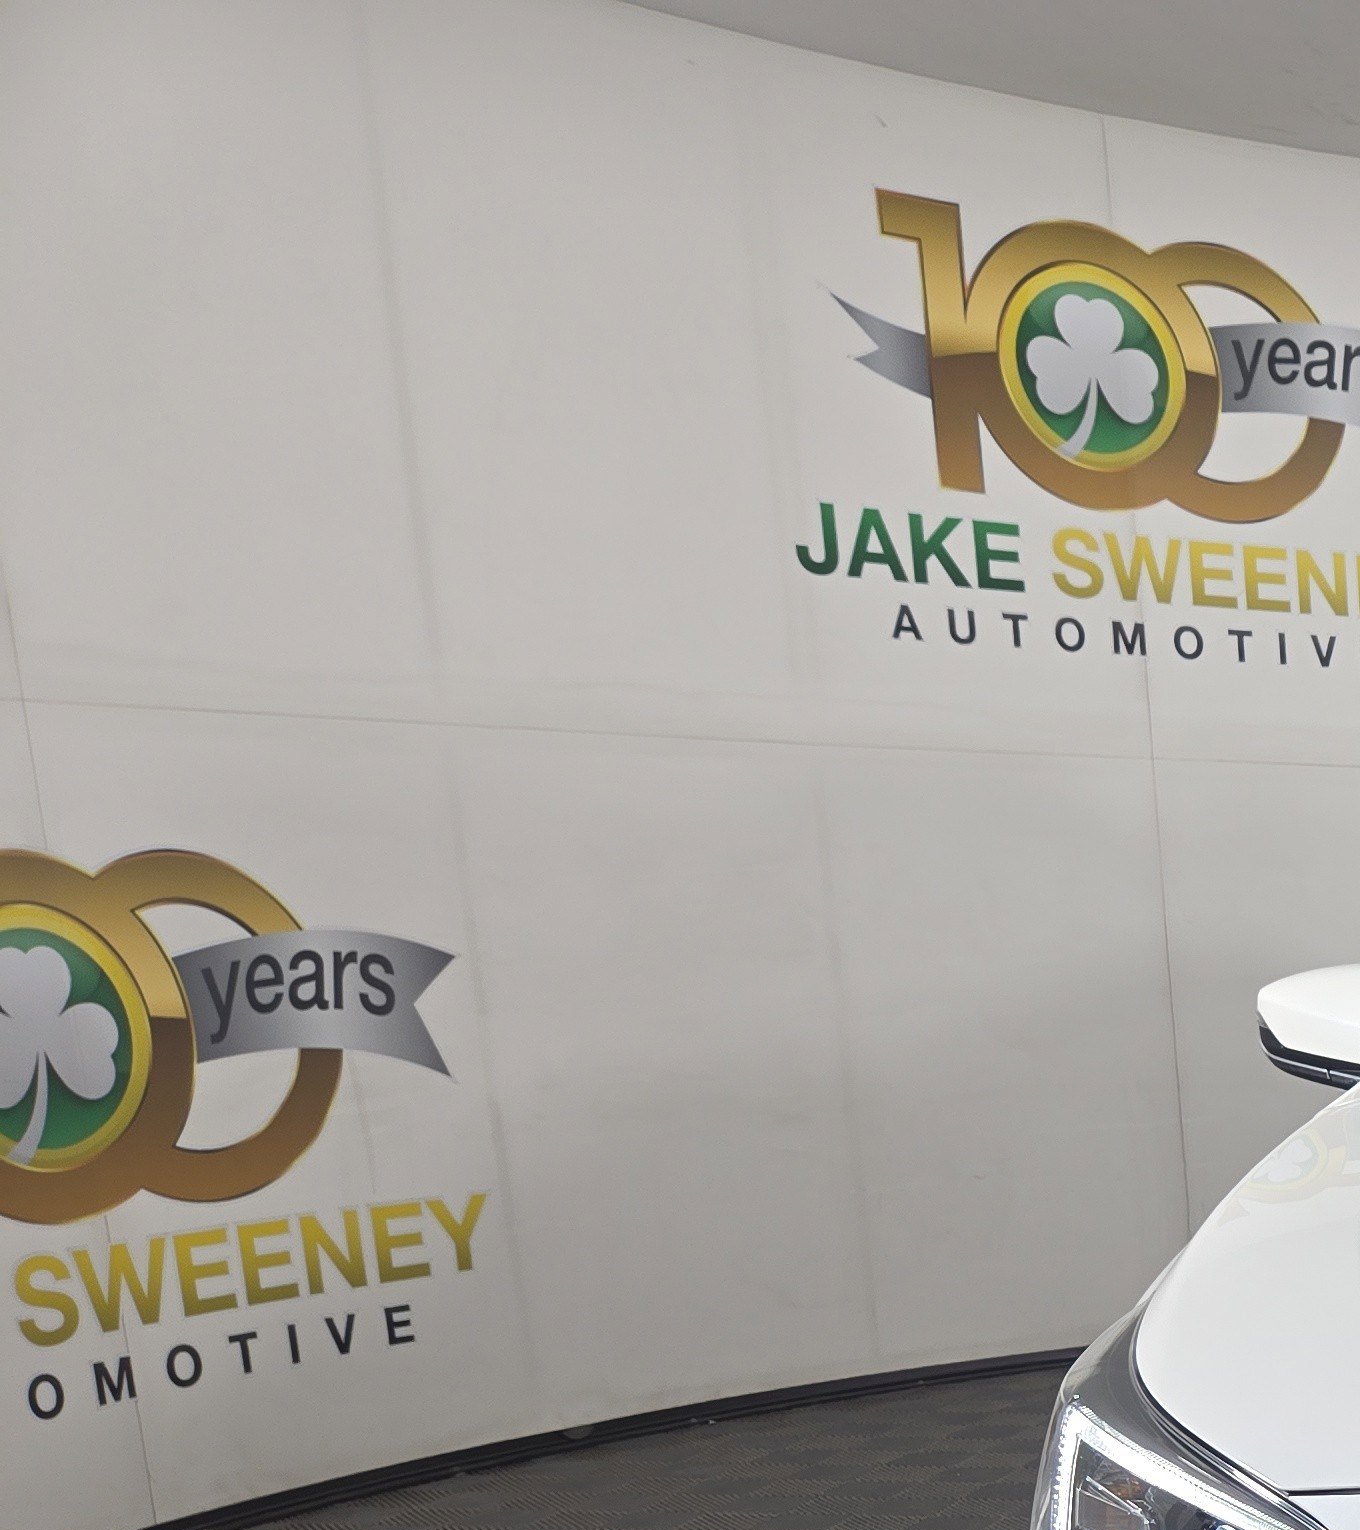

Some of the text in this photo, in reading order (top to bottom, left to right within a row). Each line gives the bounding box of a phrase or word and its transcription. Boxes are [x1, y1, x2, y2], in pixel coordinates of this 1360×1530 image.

[874, 186, 1346, 524] 100
[795, 502, 1026, 593] JAKE
[201, 948, 396, 1045] years
[14, 1192, 488, 1348] SWEENEY
[28, 1304, 415, 1420] OMOTIVE
